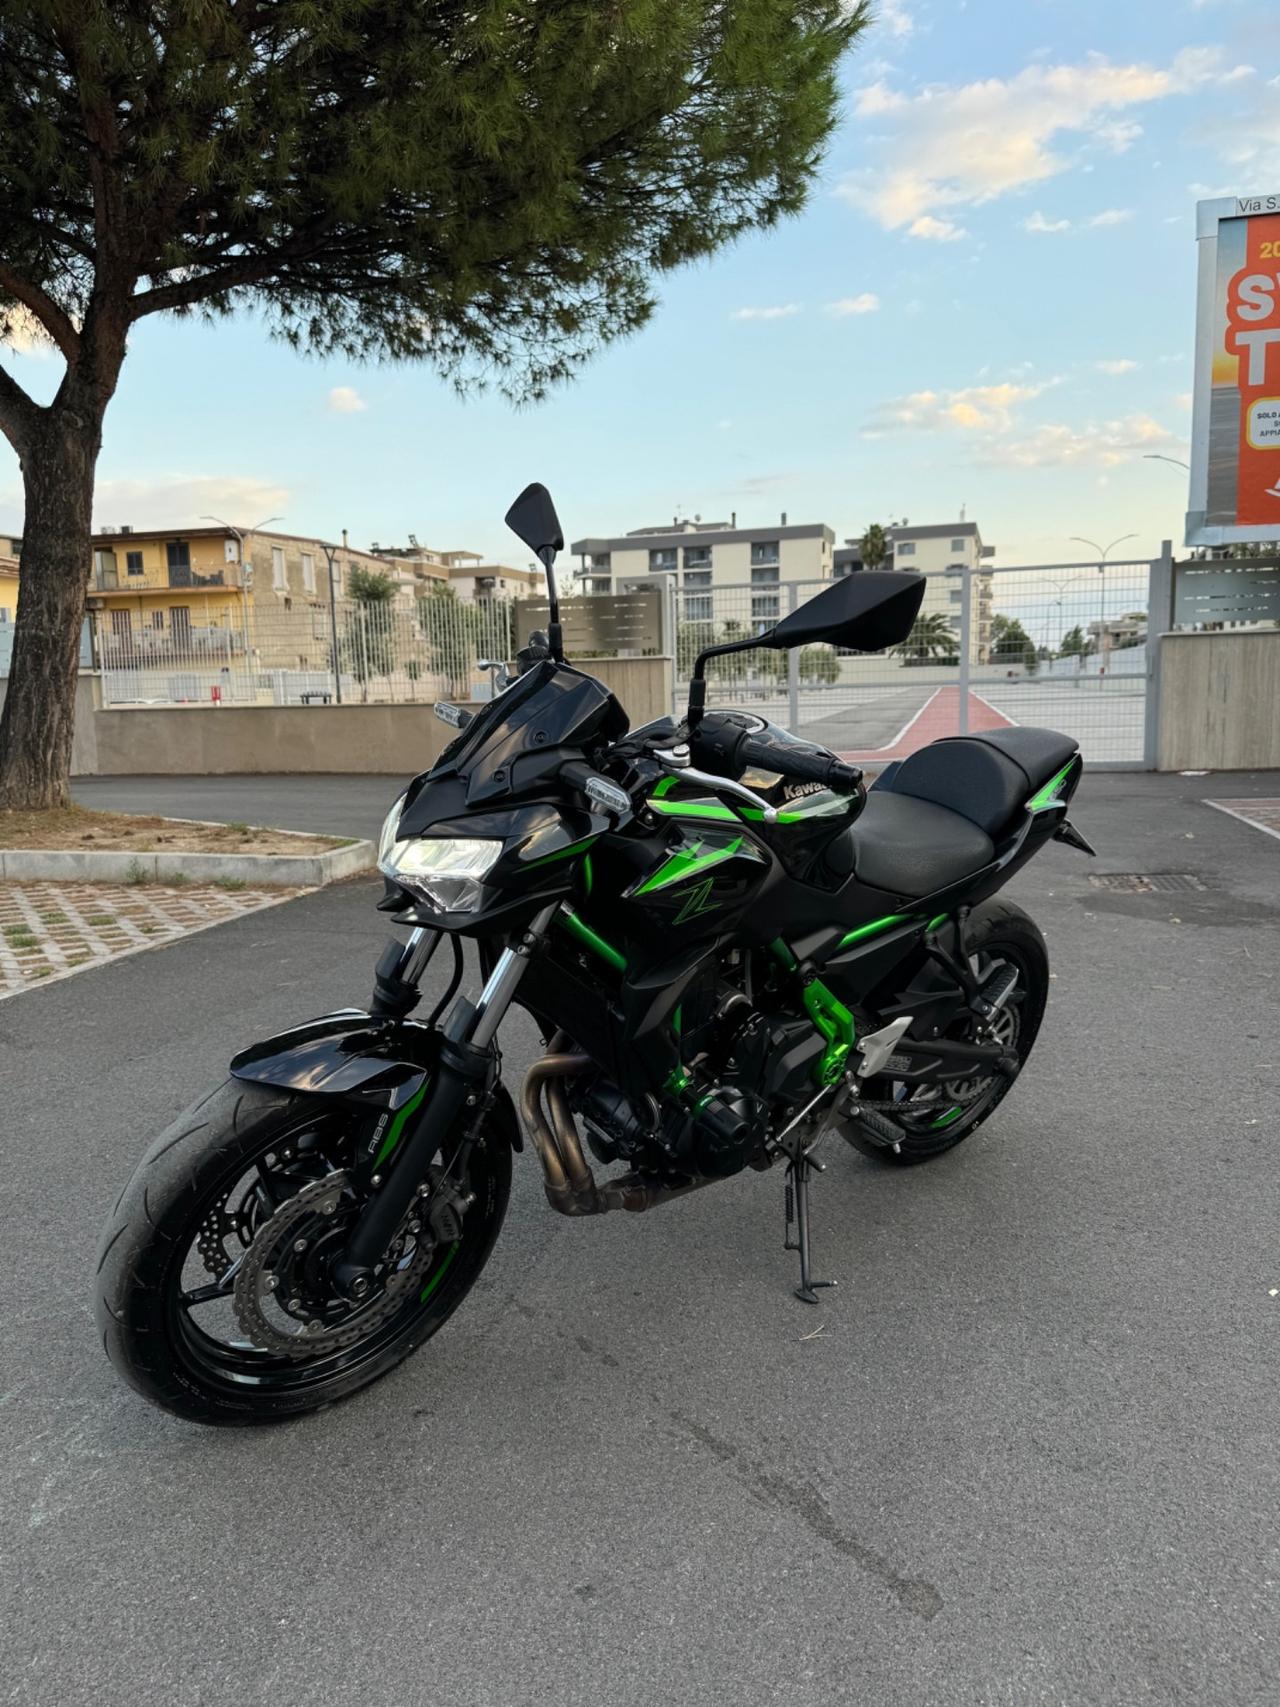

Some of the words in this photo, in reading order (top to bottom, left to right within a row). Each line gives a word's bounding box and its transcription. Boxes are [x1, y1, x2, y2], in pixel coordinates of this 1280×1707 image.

[1239, 199, 1261, 212] Via
[1237, 272, 1280, 321] S
[368, 1113, 388, 1154] ABS
